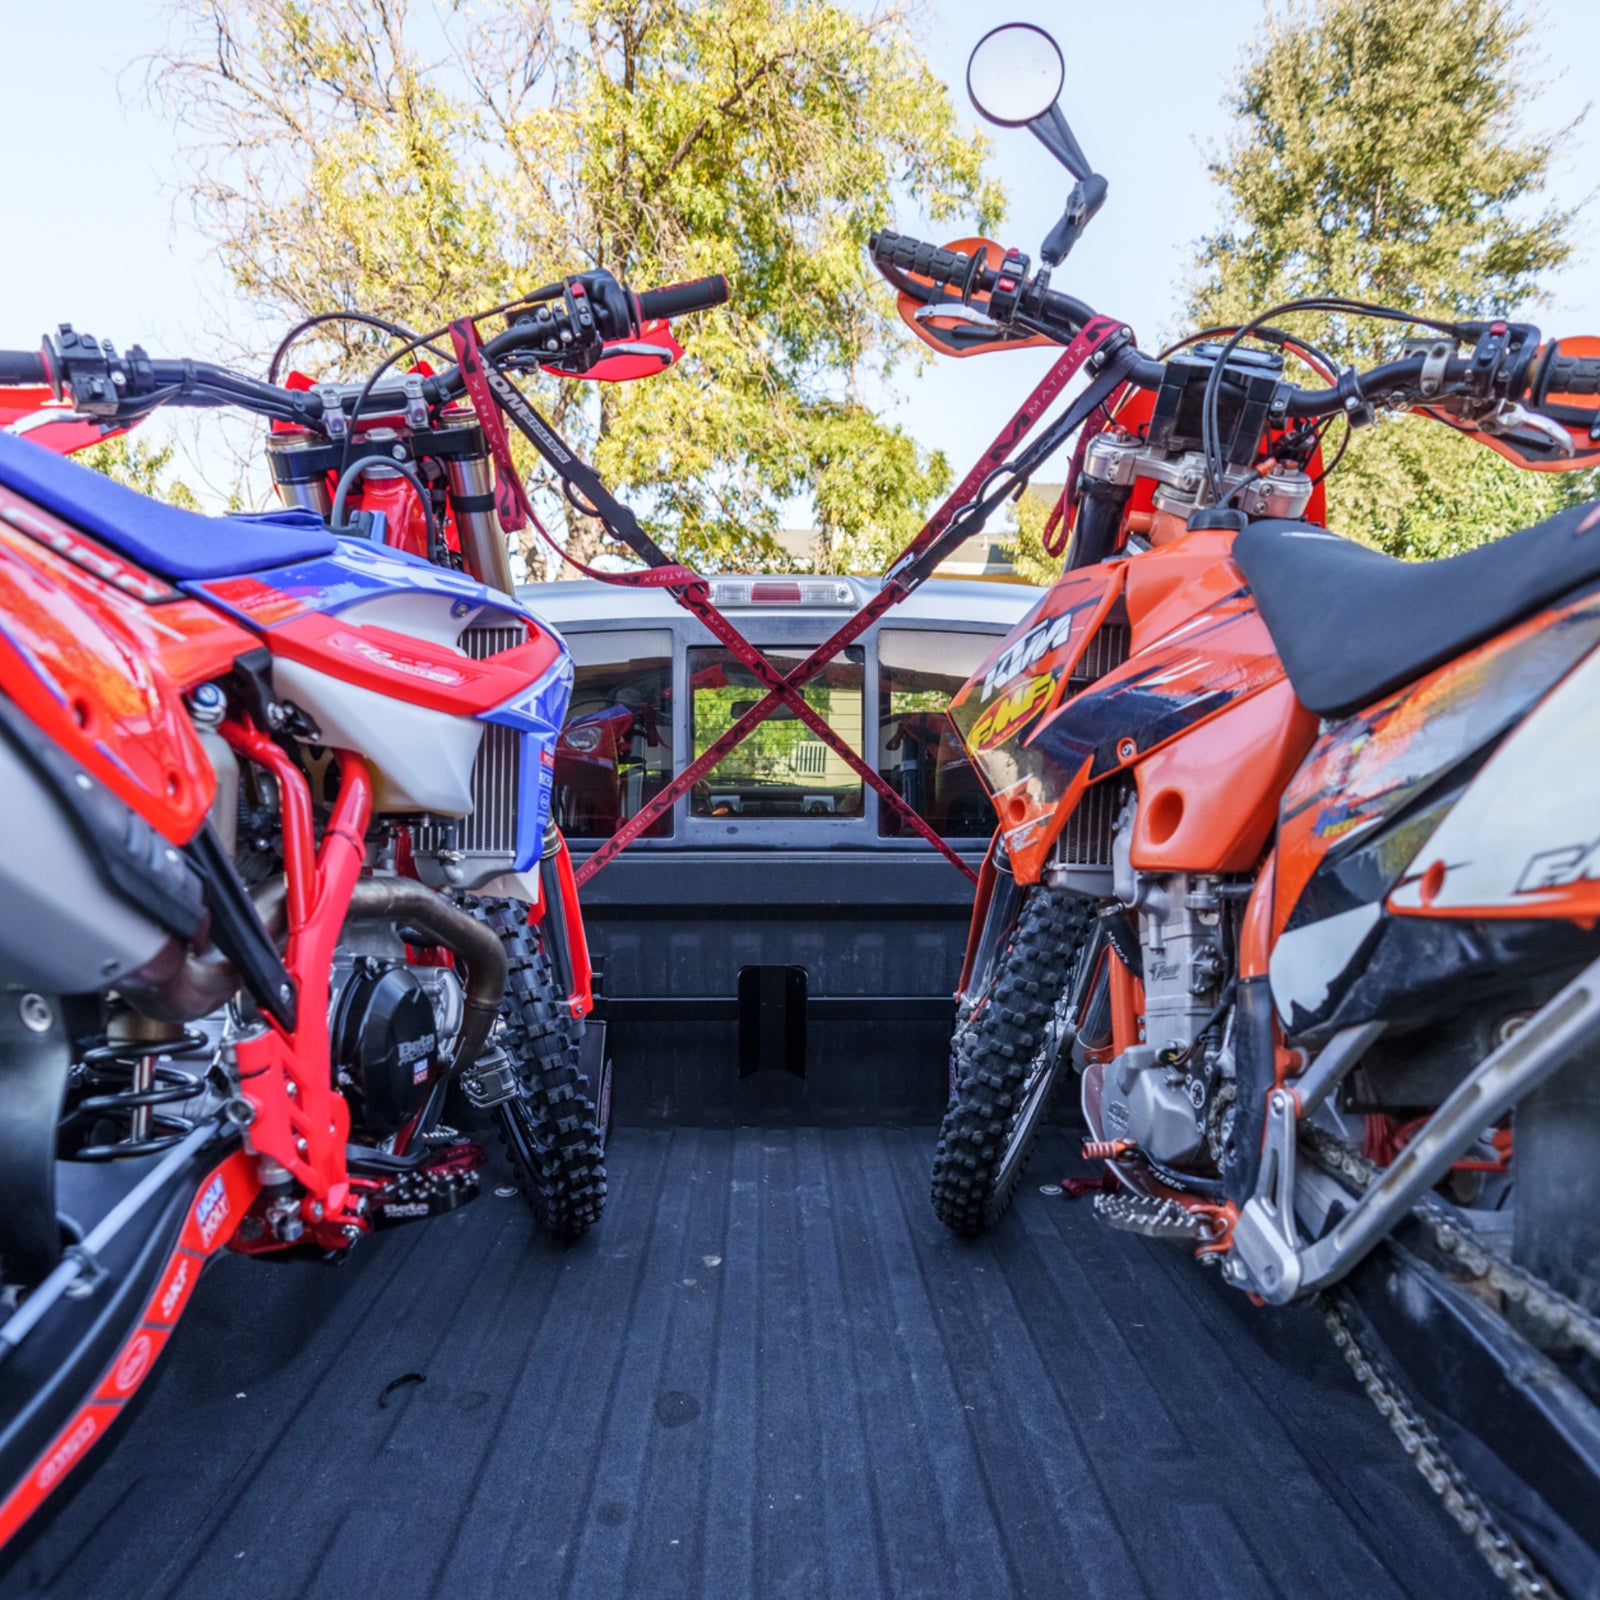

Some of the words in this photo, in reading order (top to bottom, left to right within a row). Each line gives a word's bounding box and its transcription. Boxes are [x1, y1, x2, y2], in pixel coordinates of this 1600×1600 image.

[1028, 344, 1086, 415] MATRIX
[643, 571, 693, 583] MATRIX
[708, 616, 753, 661] MATRIX
[980, 613, 1072, 704] KTM
[967, 671, 1053, 756] FMF
[618, 812, 652, 844] MATRIX
[398, 1034, 435, 1058] Beta
[1147, 1165, 1187, 1190] TUSK
